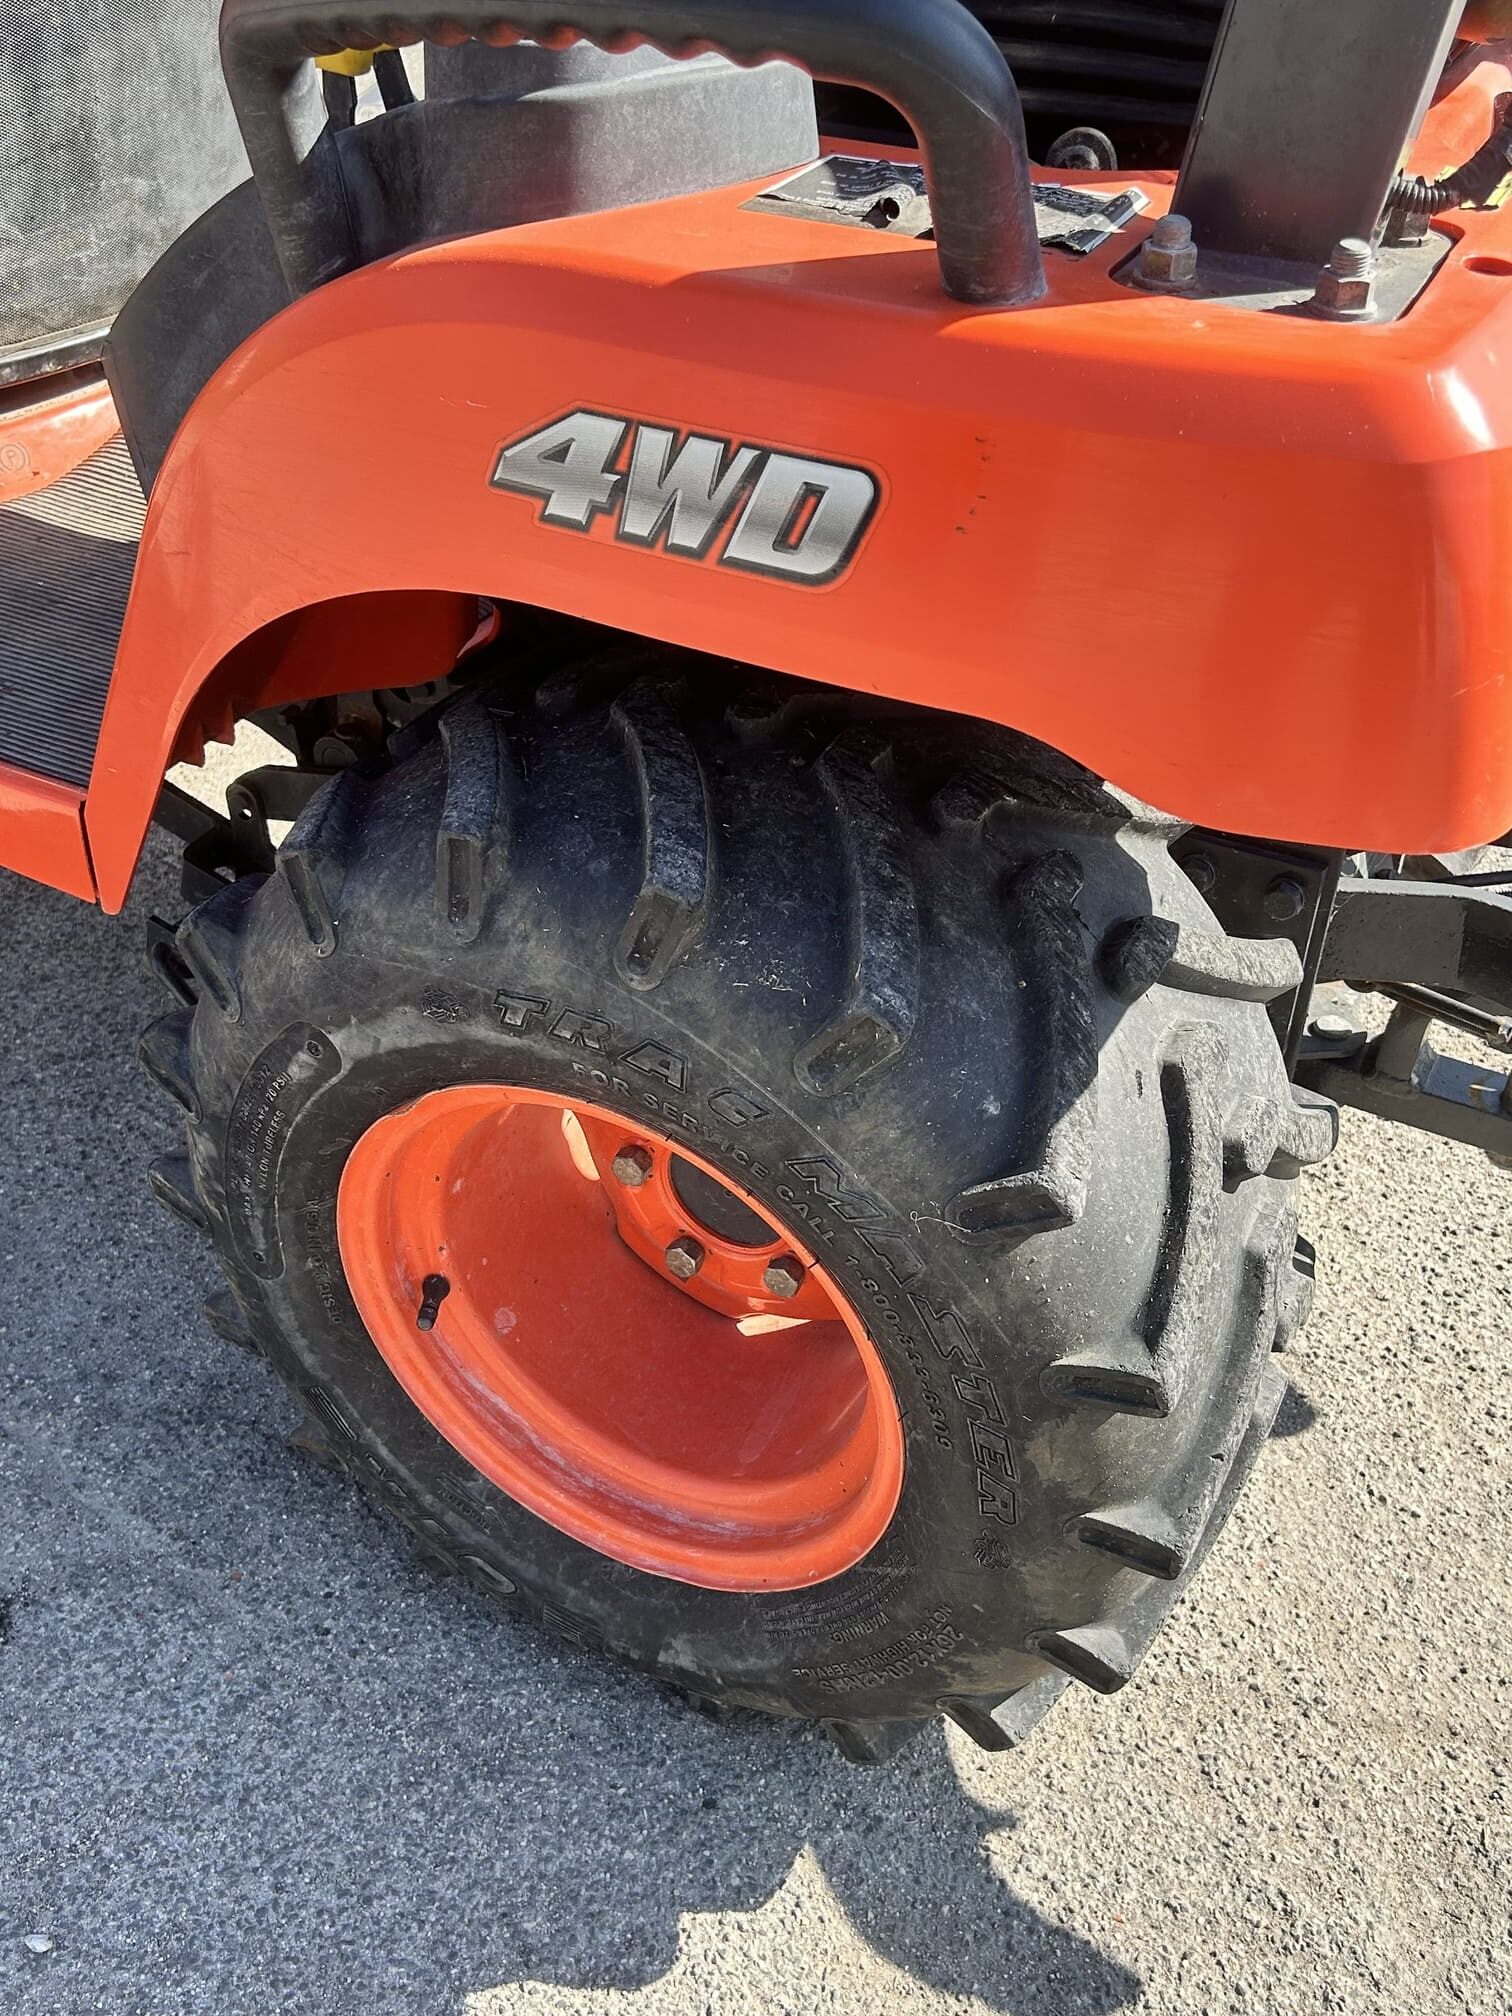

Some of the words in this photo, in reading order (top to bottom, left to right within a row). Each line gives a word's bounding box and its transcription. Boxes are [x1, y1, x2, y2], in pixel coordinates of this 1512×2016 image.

[489, 407, 882, 589] 4WD
[263, 1110, 287, 1156] TUBELESS
[571, 1059, 632, 1097] FOR
[642, 1092, 769, 1180] SERVICE
[775, 1183, 836, 1248] CALL
[492, 988, 771, 1130] TRAC
[784, 1155, 1022, 1526] MASTER
[906, 1623, 934, 1647] FOR
[929, 1604, 952, 1630] NOT
[792, 1662, 852, 1679] SERVICE
[853, 1640, 911, 1670] HIGHWAY
